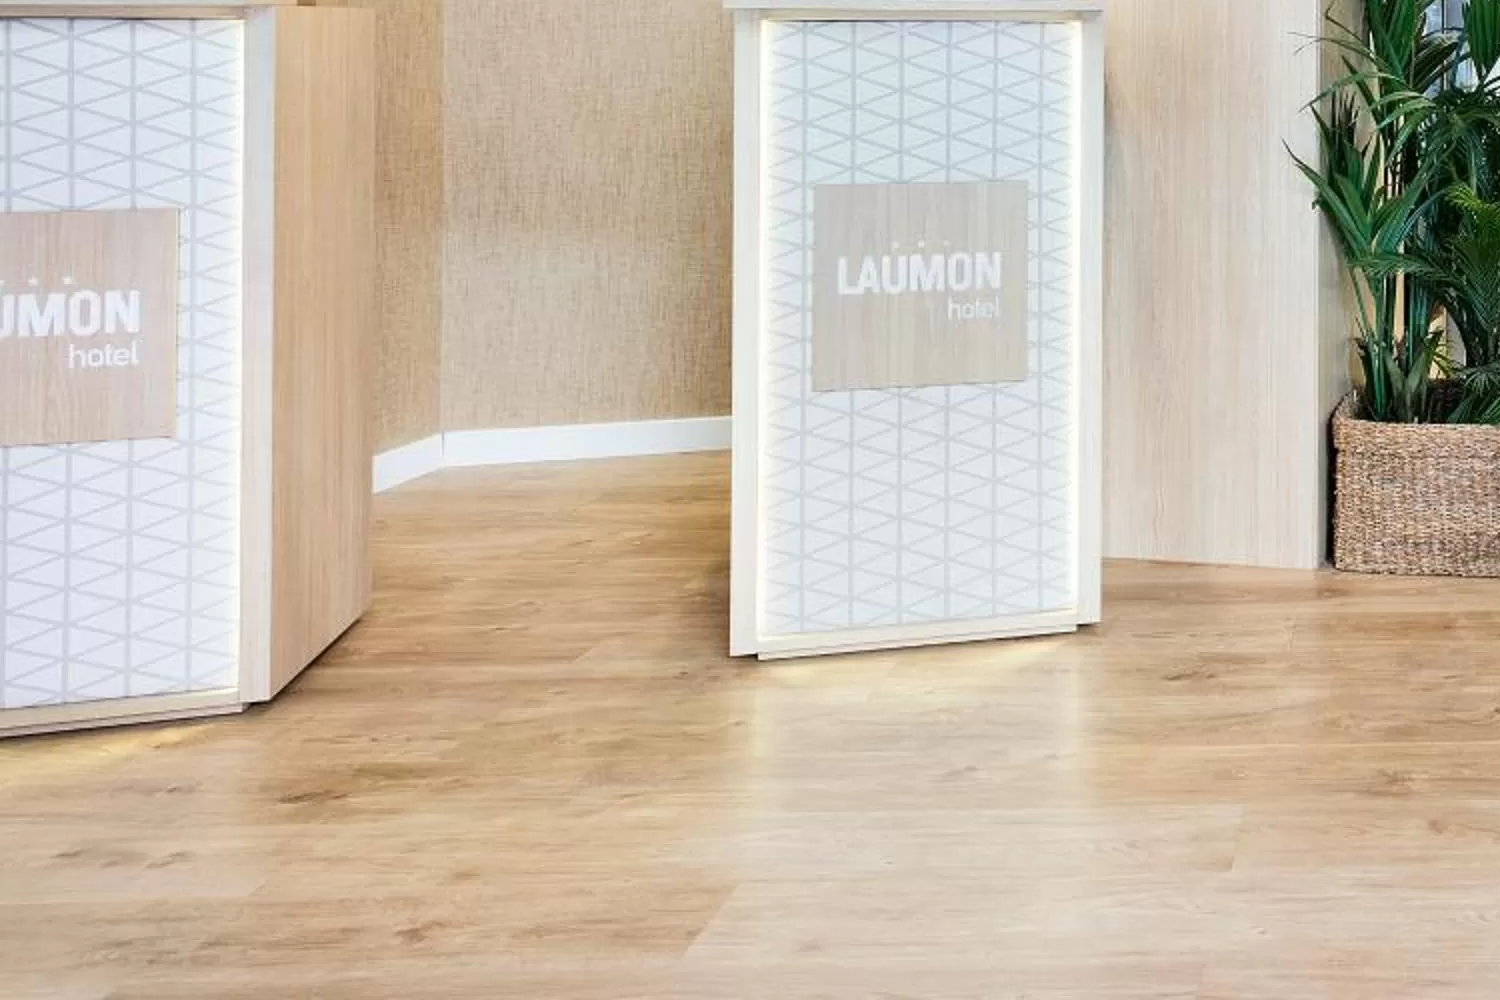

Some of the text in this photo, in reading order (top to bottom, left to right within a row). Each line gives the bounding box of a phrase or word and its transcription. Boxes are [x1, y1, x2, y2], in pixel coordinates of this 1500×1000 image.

[837, 252, 1001, 295] LAUMON
[947, 296, 999, 321] hotel
[68, 341, 139, 369] hotel
